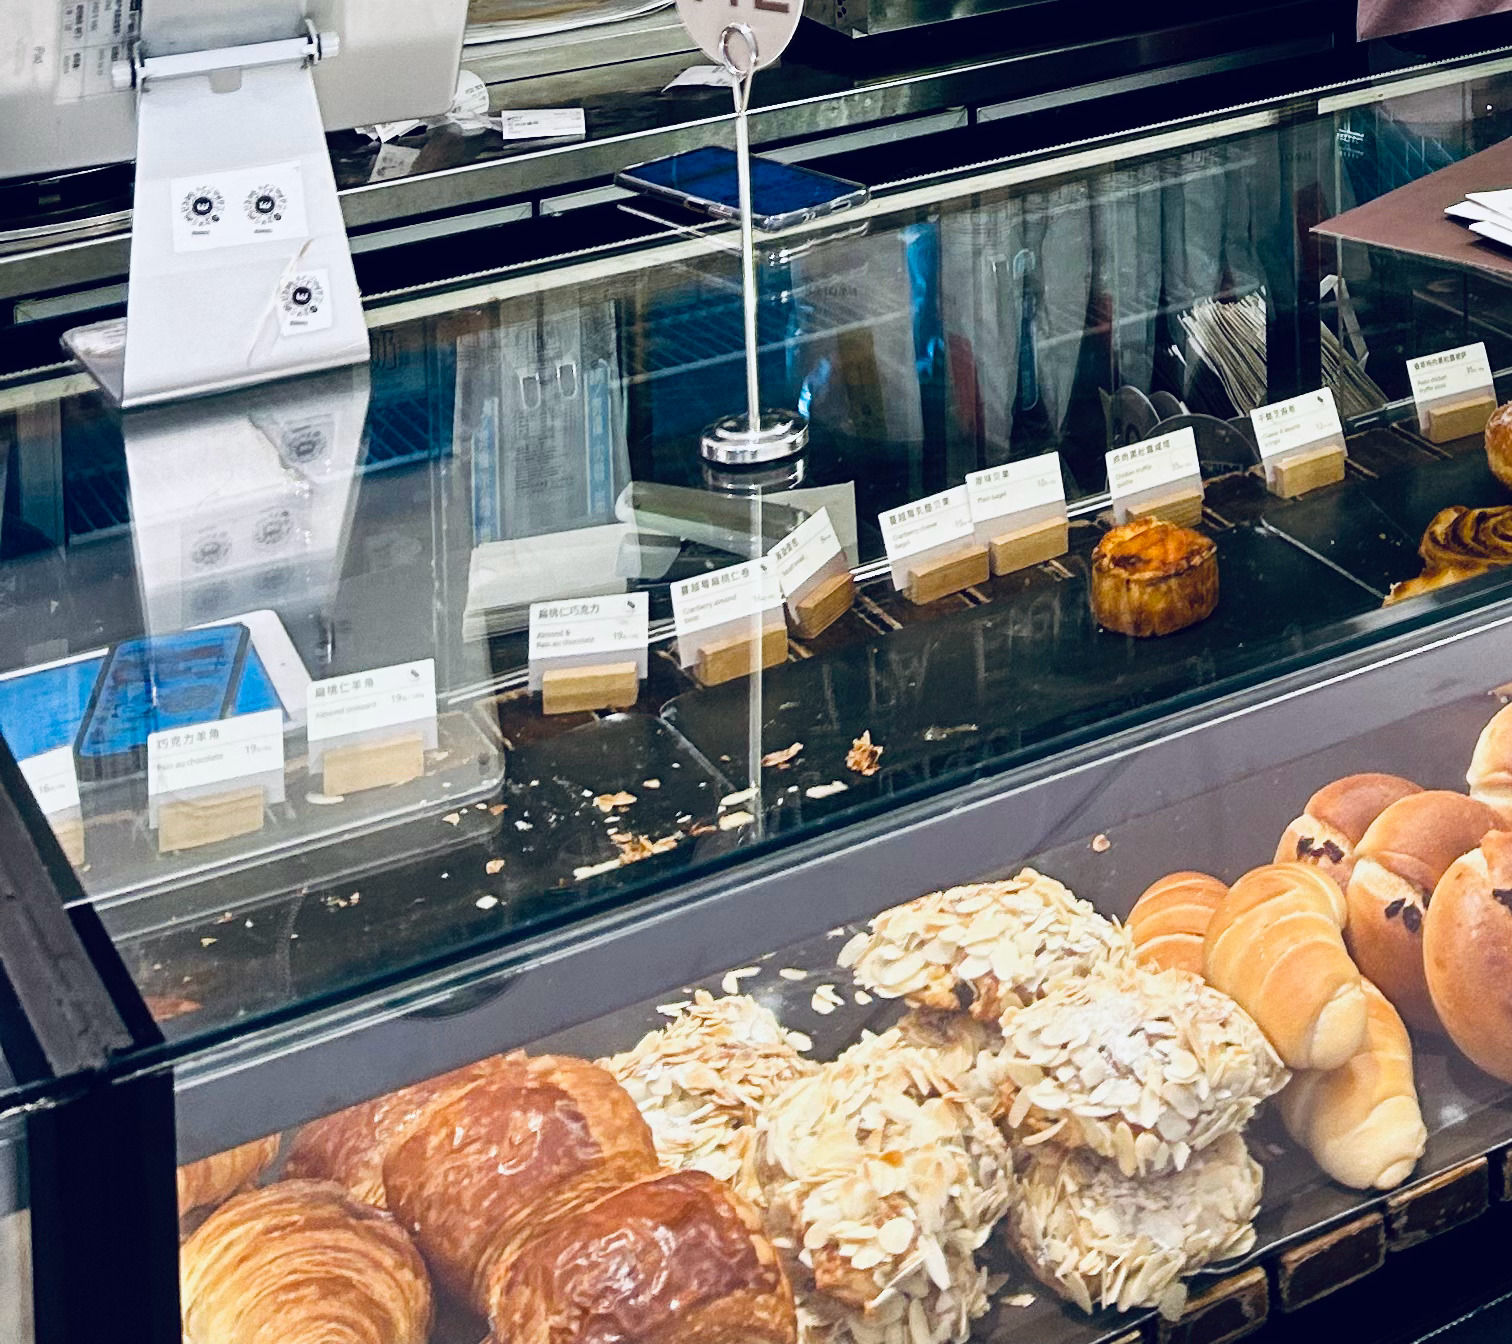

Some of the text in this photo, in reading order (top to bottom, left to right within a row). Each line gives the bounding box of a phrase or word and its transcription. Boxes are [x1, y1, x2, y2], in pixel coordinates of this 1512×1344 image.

[538, 602, 601, 620] 扁桃仁巧克力
[315, 677, 375, 698] 扁桃仁羊角
[156, 728, 220, 750] 巧克力羊角
